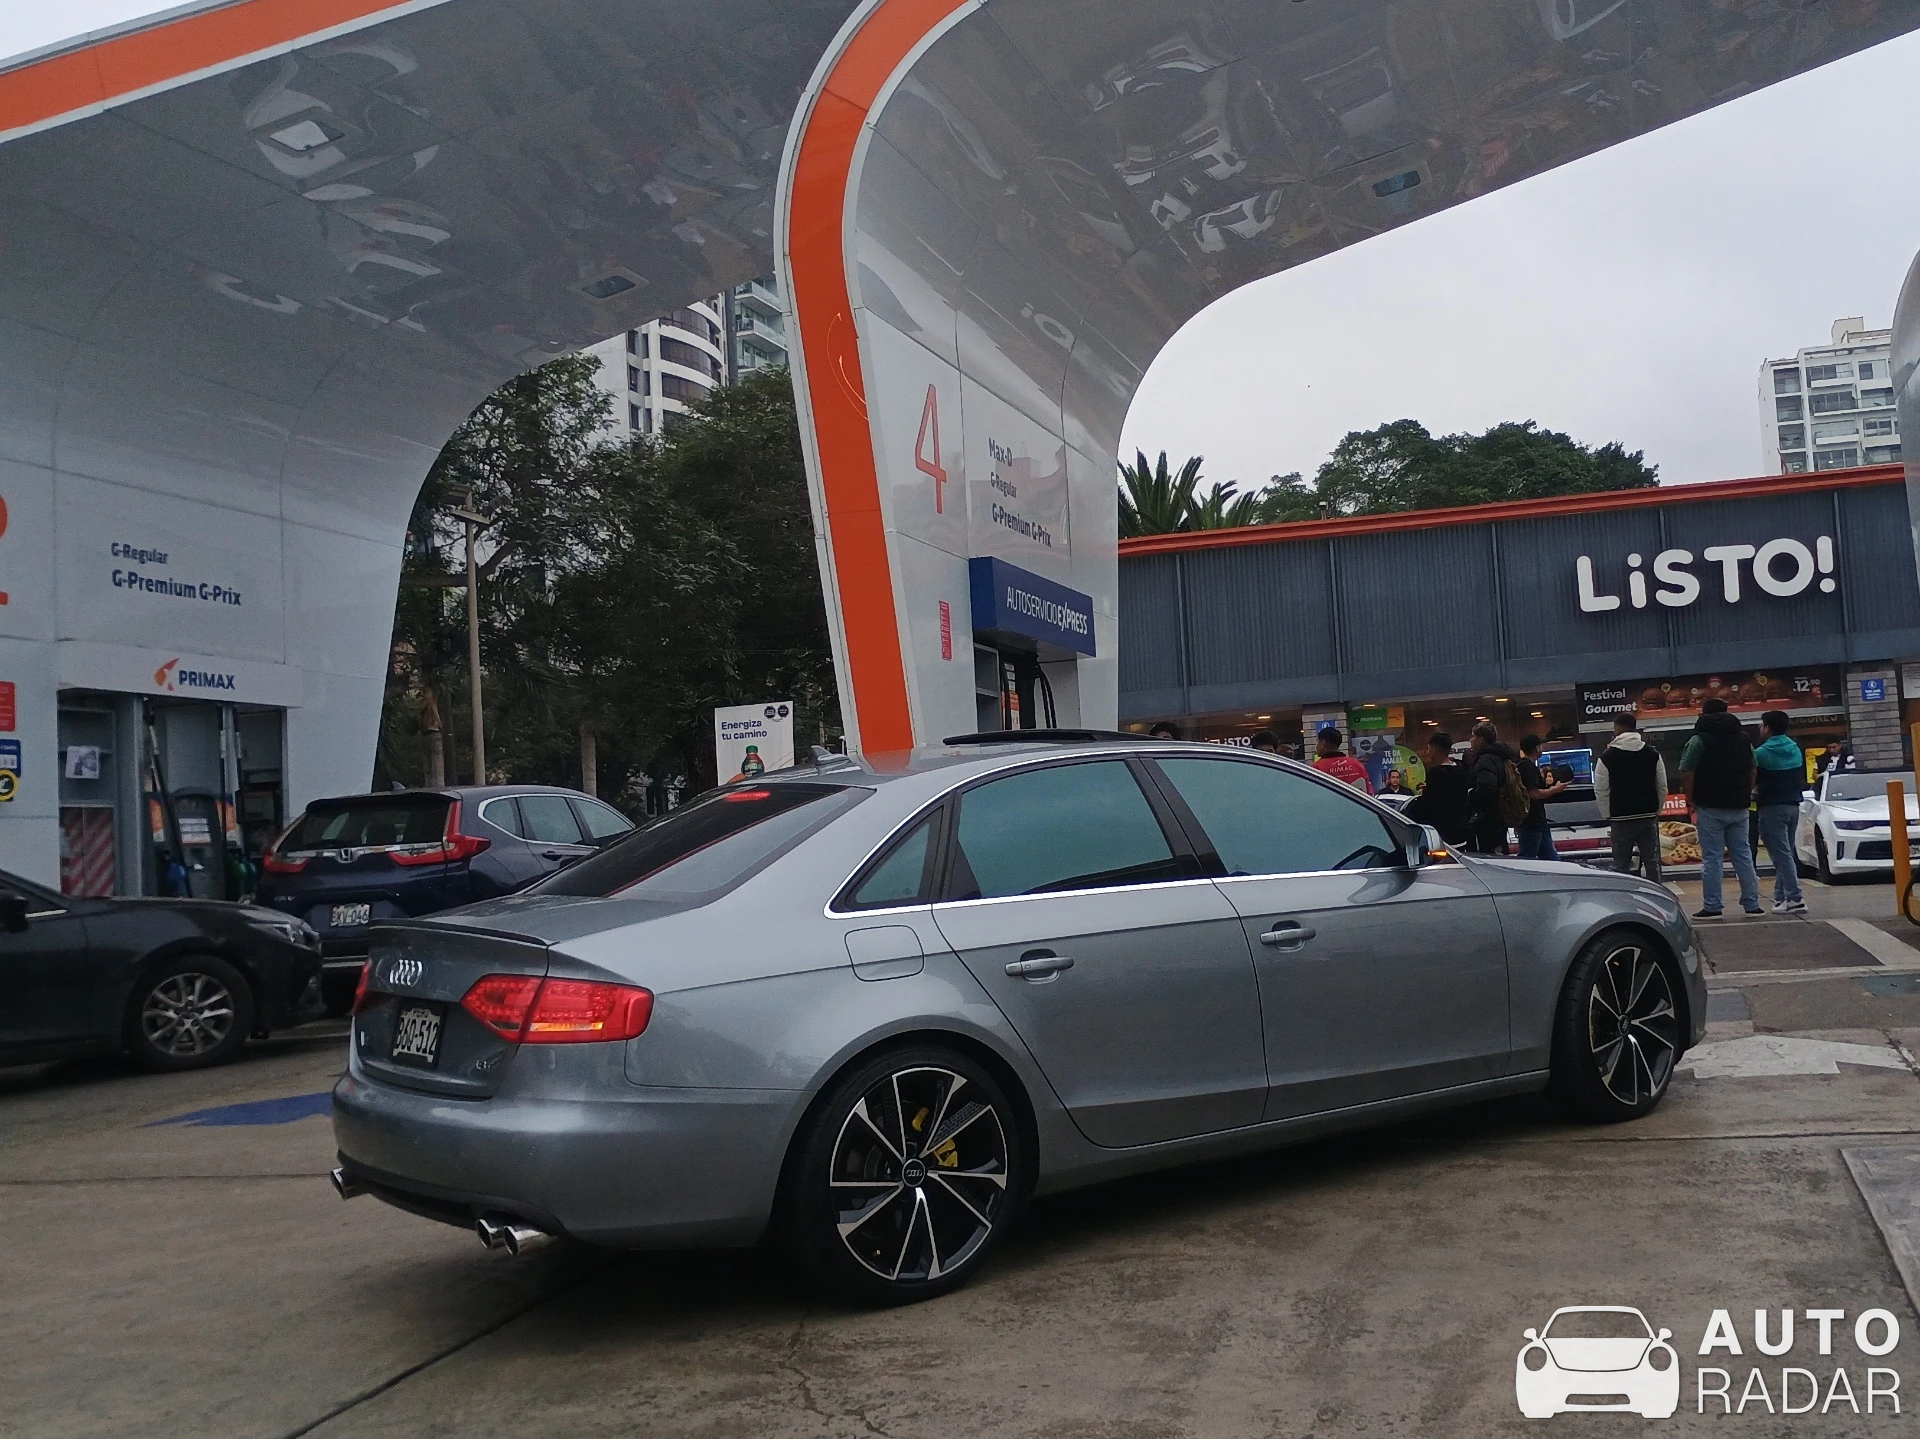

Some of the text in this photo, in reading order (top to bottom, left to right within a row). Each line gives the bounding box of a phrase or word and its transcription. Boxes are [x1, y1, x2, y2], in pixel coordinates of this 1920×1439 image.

[915, 384, 947, 515] 4
[988, 437, 1012, 467] Max-D
[991, 472, 1017, 498] G-Regular
[992, 503, 1052, 548] G-Premium G-Prix
[111, 542, 169, 564] G-Regular
[112, 569, 242, 605] G-Premium G-Prix
[179, 670, 236, 690] PRIMAX
[1584, 688, 1626, 701] Festival
[1585, 701, 1638, 715] Gourmet
[721, 719, 762, 730] Energiza
[722, 730, 768, 741] tu camino
[1329, 766, 1353, 774] RIMAC
